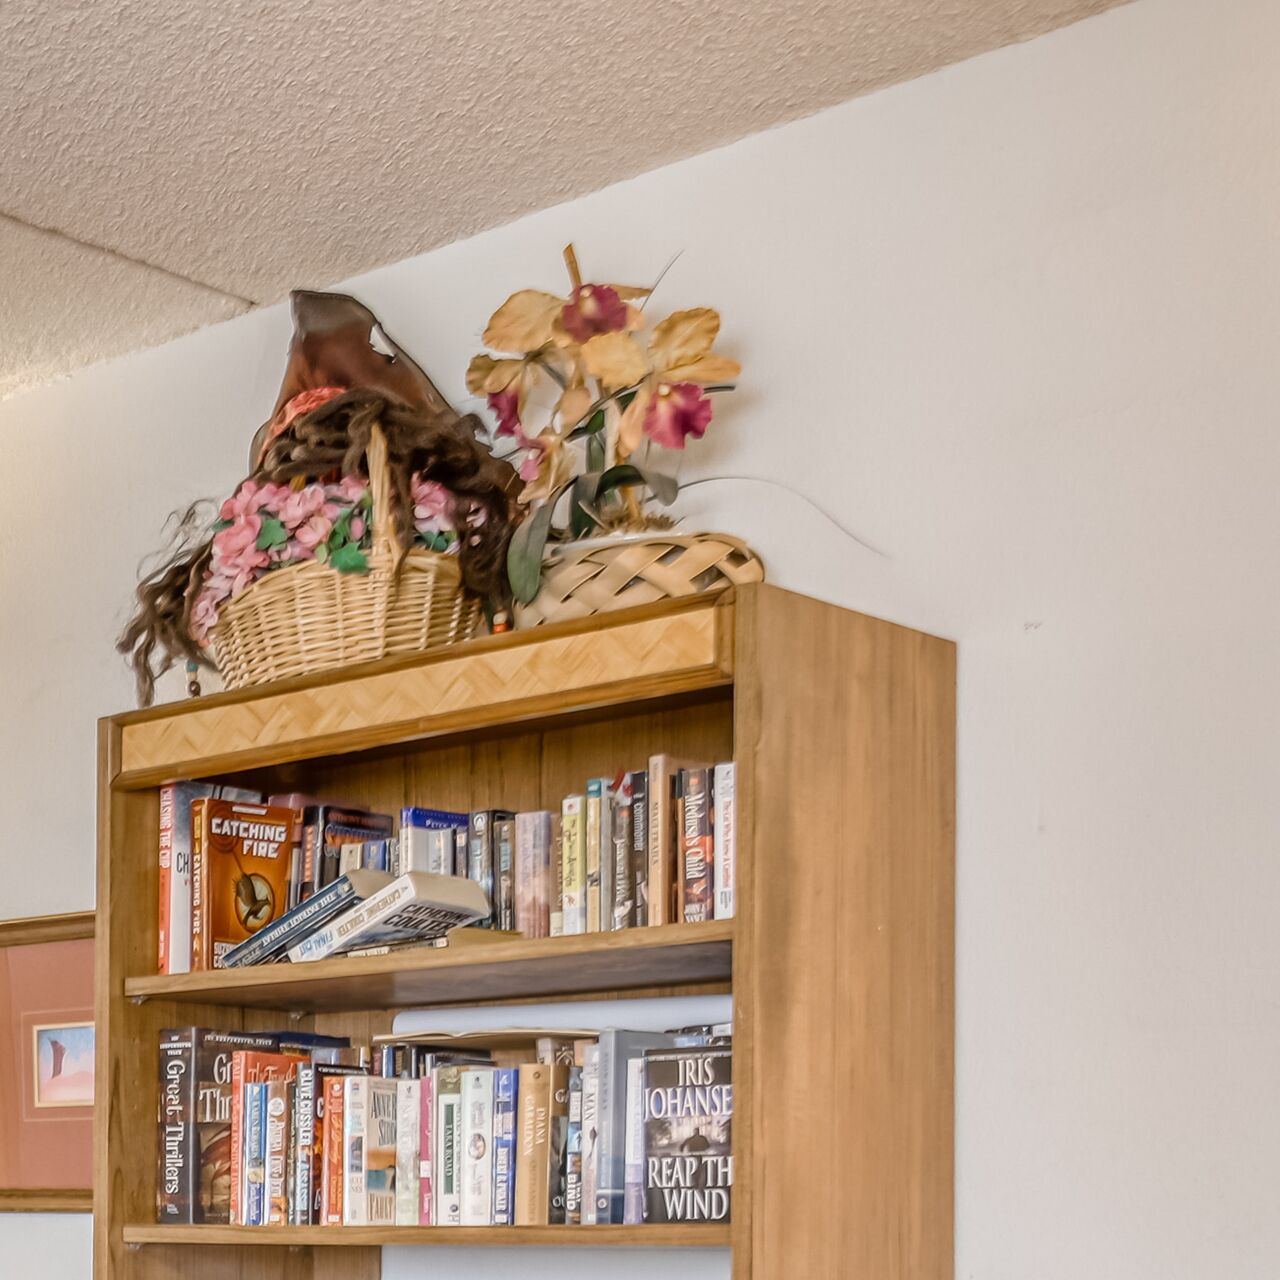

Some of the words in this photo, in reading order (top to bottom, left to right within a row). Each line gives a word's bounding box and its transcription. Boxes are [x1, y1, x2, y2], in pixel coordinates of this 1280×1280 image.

[211, 817, 287, 842] CATCHING
[633, 802, 645, 852] commoner
[684, 791, 706, 846] Medusa's
[159, 831, 172, 849] THE
[242, 839, 281, 859] FIRE
[685, 848, 707, 880] Child
[192, 855, 202, 907] CATCHING
[192, 909, 201, 935] FIRE
[166, 1059, 185, 1116] Great
[300, 1069, 312, 1098] CLIVE
[678, 1058, 715, 1087] IRIS
[584, 1093, 596, 1121] MAN
[644, 1085, 733, 1122] JOHANSE
[300, 1099, 312, 1146] CUSSLER
[536, 1107, 546, 1145] DIANA
[165, 1120, 185, 1194] Thrillers
[648, 1156, 697, 1188] REAP
[702, 1155, 733, 1187] TH
[566, 1174, 577, 1211] BIND
[663, 1188, 729, 1220] WIND
